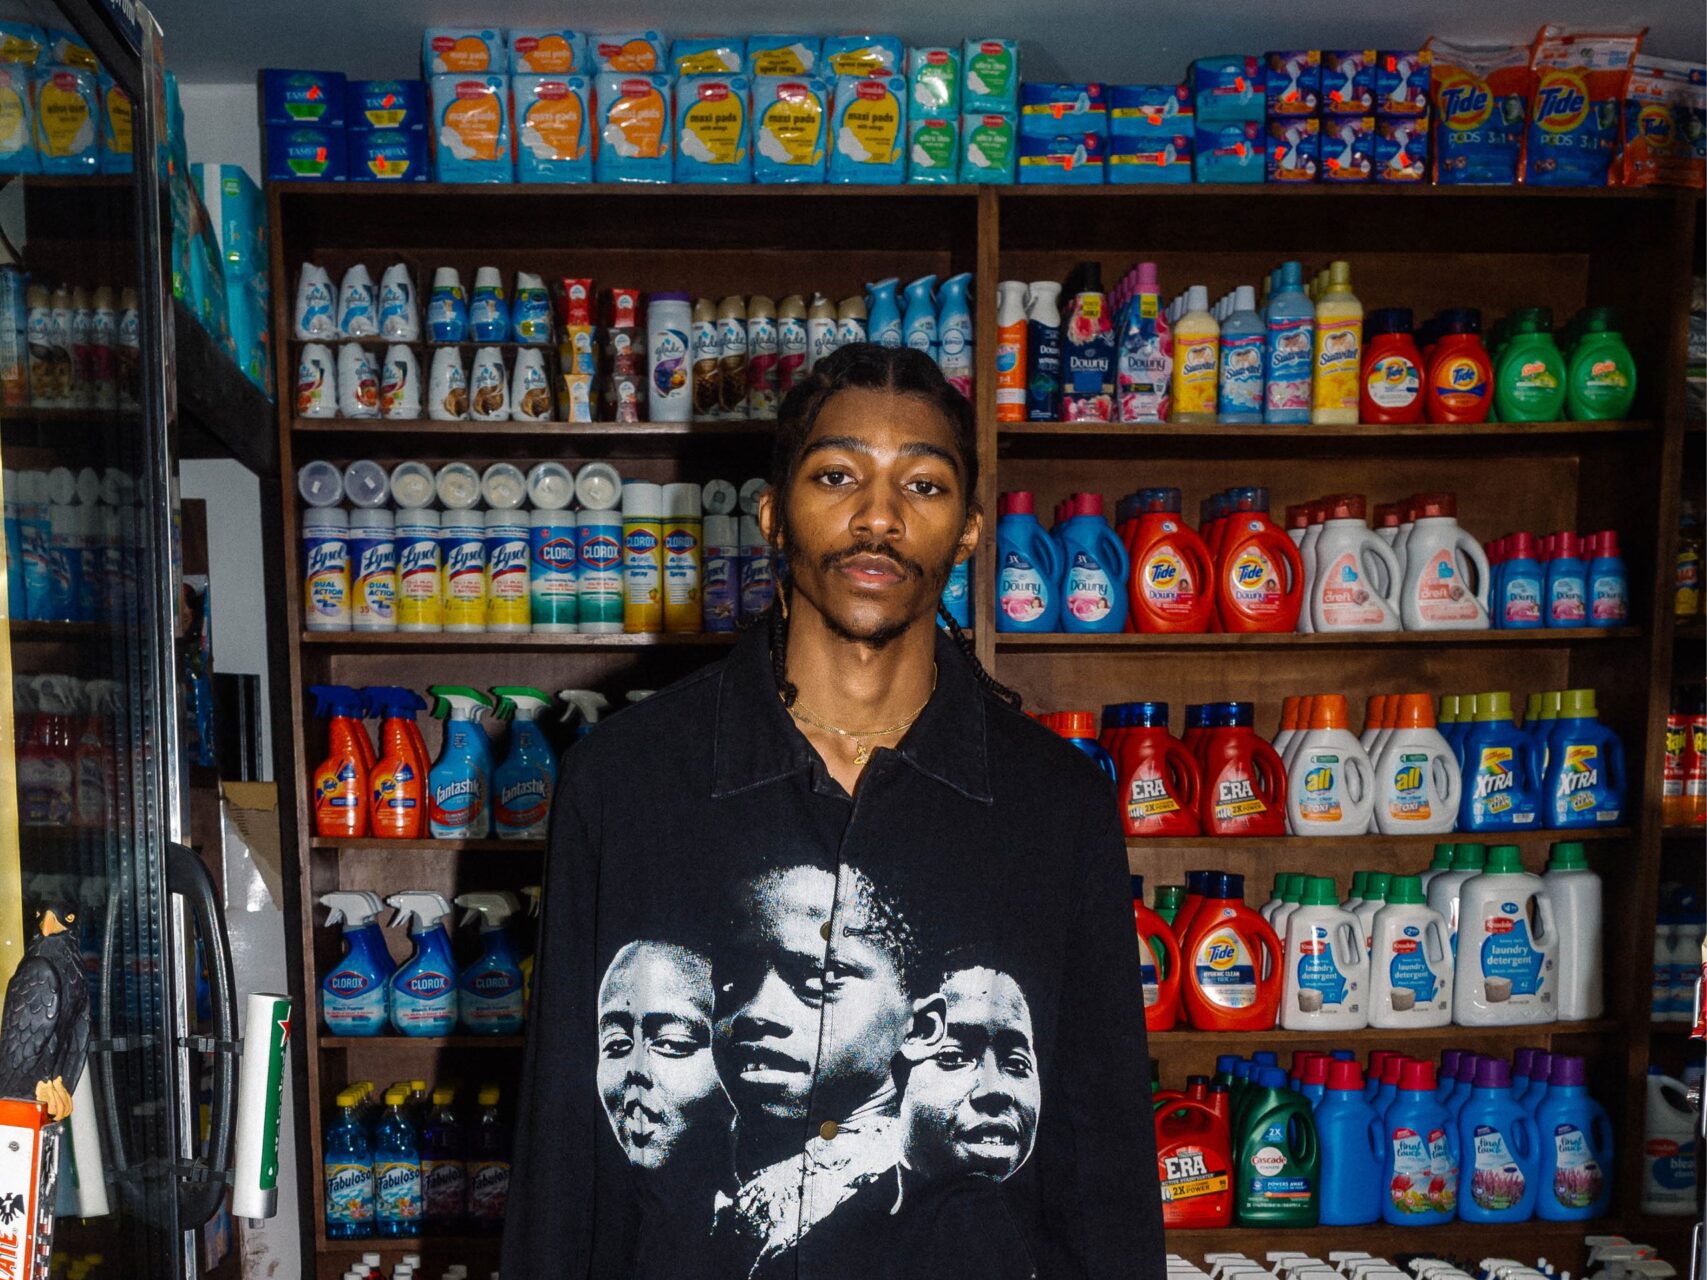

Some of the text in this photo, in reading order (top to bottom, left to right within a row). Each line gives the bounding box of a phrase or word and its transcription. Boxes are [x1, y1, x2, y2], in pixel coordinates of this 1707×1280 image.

[1442, 82, 1488, 119] Tide
[1536, 87, 1584, 120] Tide
[690, 113, 737, 126] maxi pads
[769, 114, 815, 127] maxi pads
[848, 112, 894, 125] maxi pads
[655, 344, 684, 358] glade
[1070, 356, 1109, 372] Downy
[1128, 356, 1166, 372] Downy
[1385, 366, 1405, 380] Tide
[1452, 367, 1476, 385] Tide
[627, 536, 657, 548] CLOROX
[666, 536, 694, 548] CLOROX
[311, 546, 344, 570] Lysol
[403, 545, 438, 569] Lysol
[450, 545, 485, 569] Lysol
[493, 545, 527, 569] Lysol
[543, 547, 575, 560] CLORO
[583, 545, 619, 561] CLOROX
[1151, 563, 1177, 582] Tide
[1238, 563, 1264, 583] Tide
[314, 588, 343, 596] ACTION
[1003, 581, 1041, 596] Downy
[1070, 581, 1107, 597] Downy
[1150, 590, 1177, 602] Downy
[1236, 590, 1264, 602] Downy
[1421, 585, 1449, 600] dreft
[1325, 590, 1351, 604] dreft
[1305, 767, 1334, 793] all
[1395, 766, 1421, 792] all
[1473, 771, 1514, 802] XTRA
[1559, 769, 1599, 799] XTRA
[436, 778, 480, 803] fantastik
[1132, 779, 1168, 799] ERA
[1219, 780, 1254, 800] ERA
[1144, 803, 1156, 812] 2X
[1232, 803, 1243, 813] 2X
[1209, 944, 1235, 963] Tide
[1492, 945, 1529, 956] laundry
[1398, 963, 1425, 973] laundry
[1487, 956, 1532, 968] detergent
[332, 977, 363, 989] CLOROX
[475, 977, 509, 989] CLOROX
[1302, 971, 1337, 982] detergent
[1394, 970, 1429, 981] detergent
[411, 978, 445, 990] CLOROX
[1269, 1127, 1281, 1137] 2X
[1165, 1155, 1207, 1178] ERA
[1251, 1156, 1287, 1166] Cascade
[329, 1168, 371, 1193] Fabuloso
[377, 1168, 420, 1192] Fabuloso
[1173, 1187, 1186, 1197] 2X
